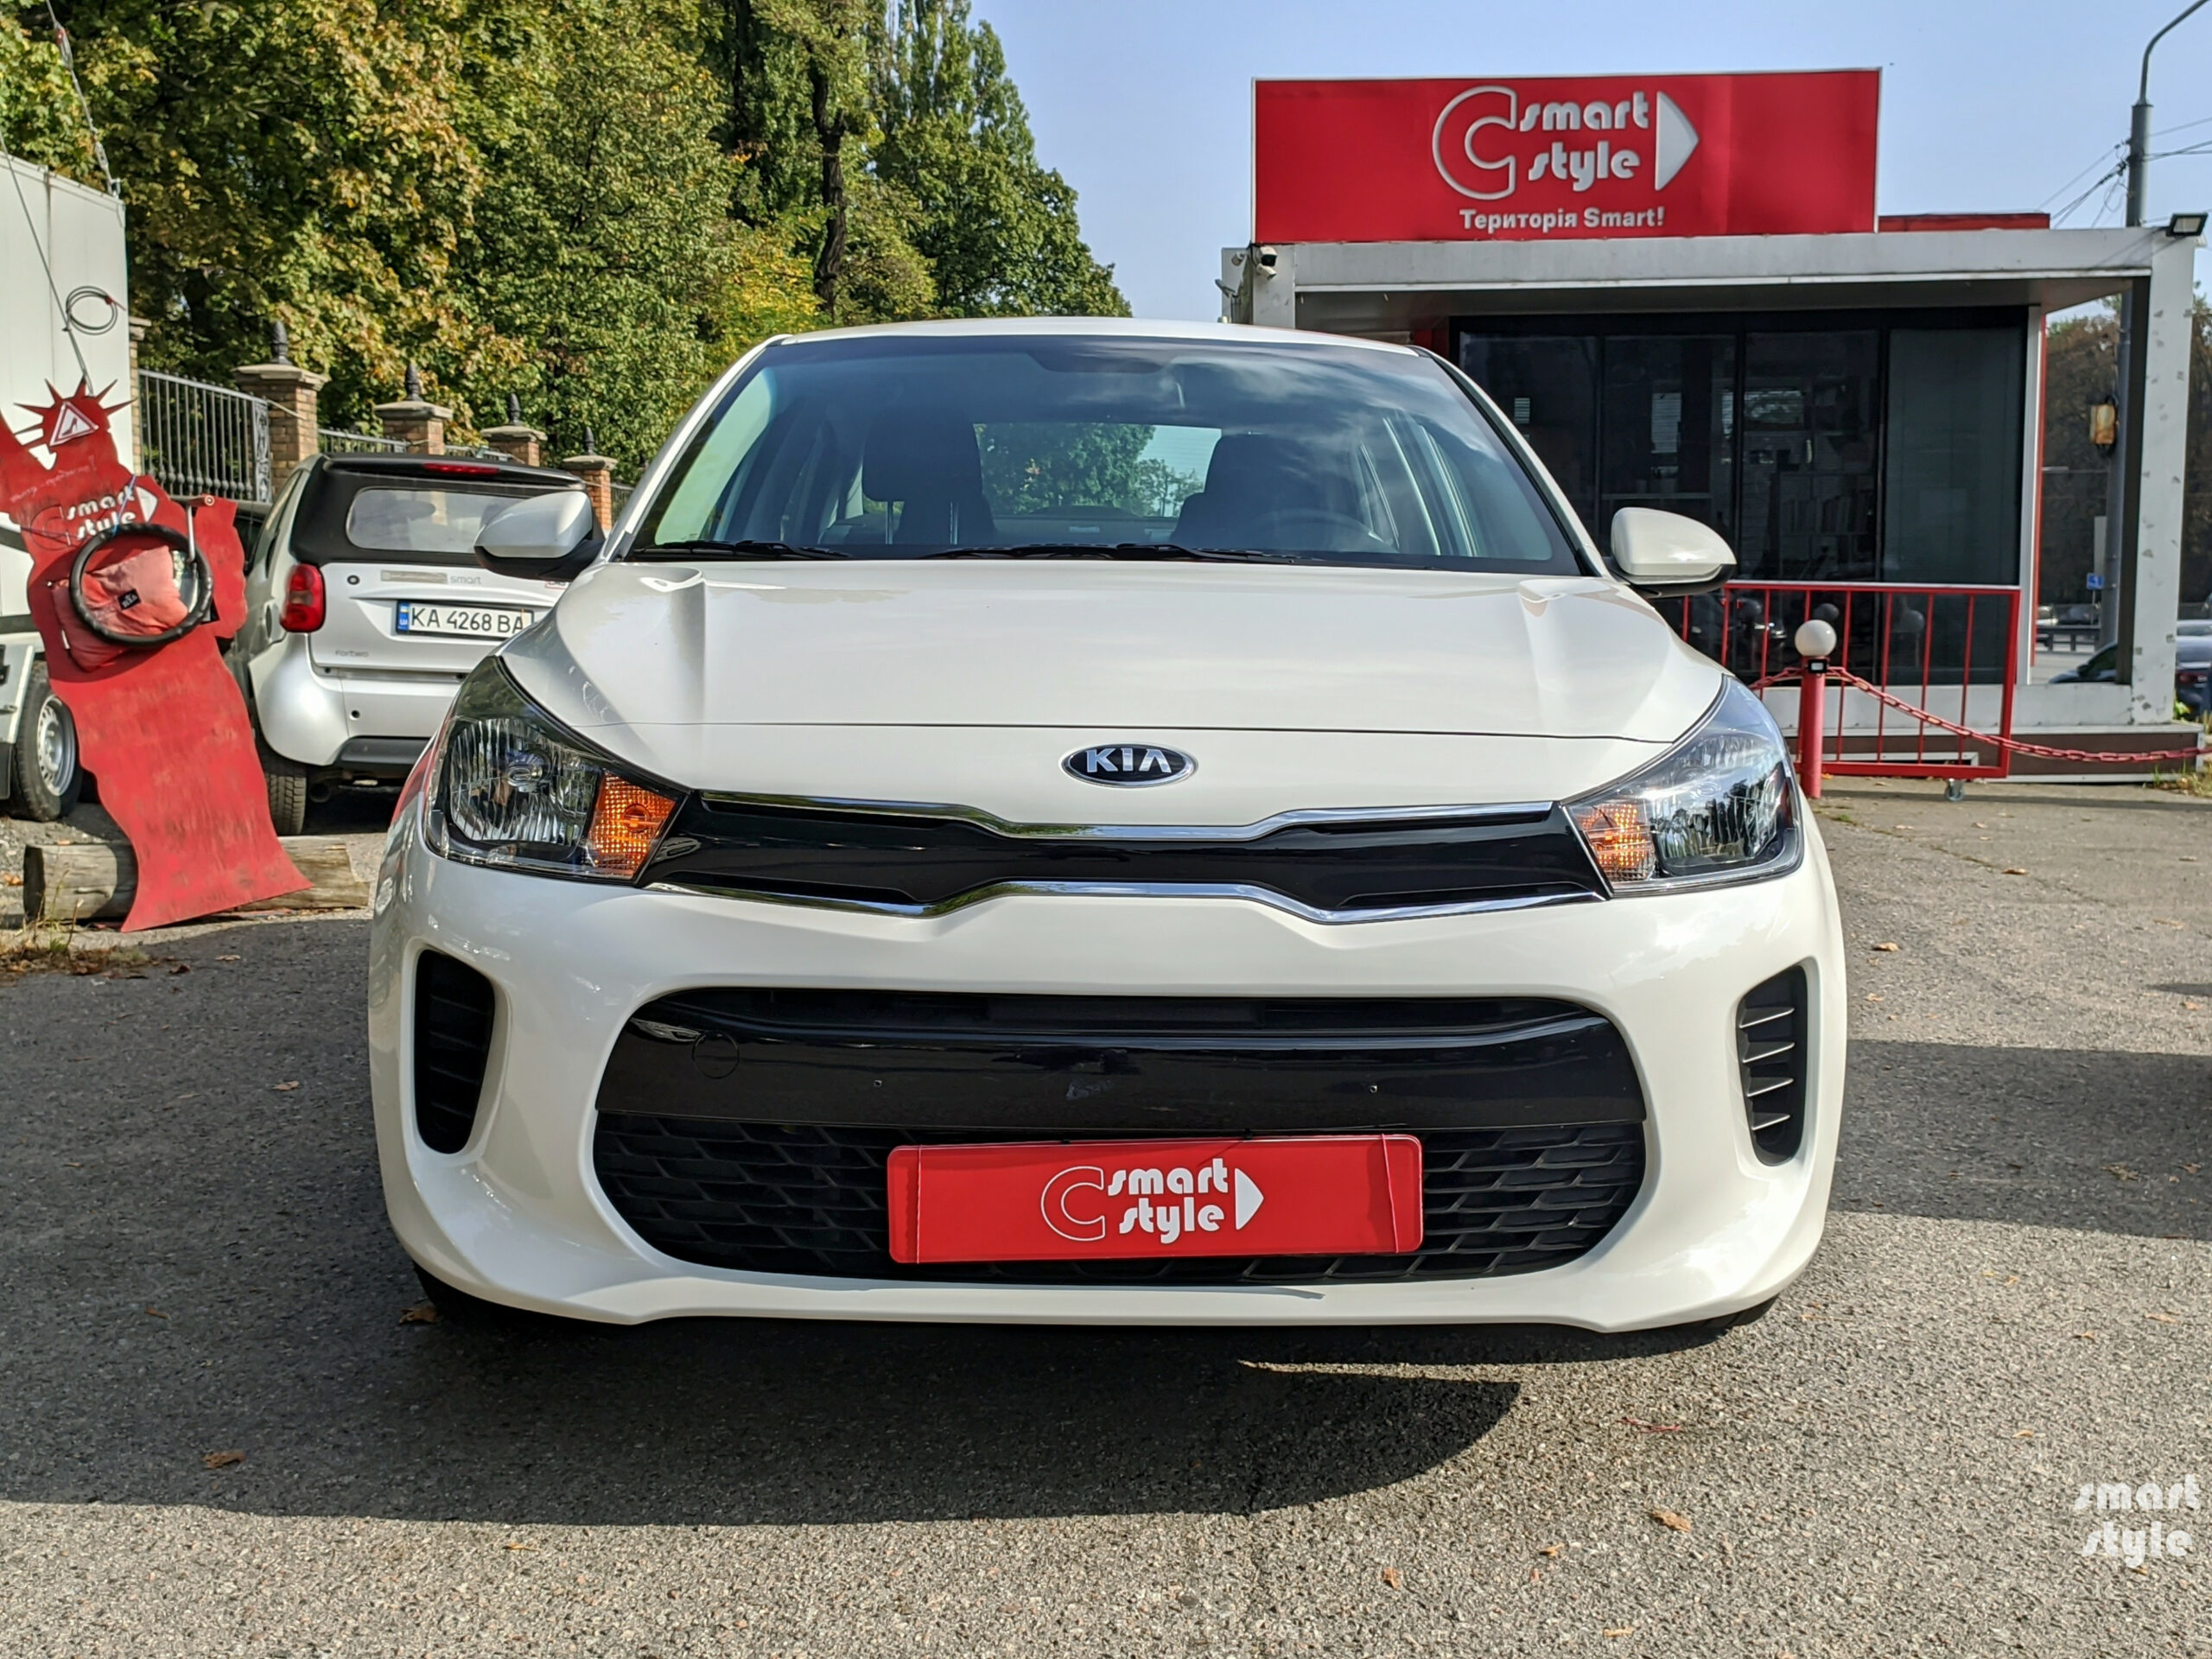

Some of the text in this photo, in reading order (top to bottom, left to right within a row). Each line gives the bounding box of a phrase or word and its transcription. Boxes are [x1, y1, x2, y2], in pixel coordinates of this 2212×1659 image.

[1519, 90, 1649, 132] smart
[1528, 140, 1641, 192] style
[1459, 207, 1665, 234] Територія Smart!
[67, 485, 136, 521] smart
[449, 575, 482, 585] smart
[410, 607, 441, 628] KA
[446, 611, 493, 632] 4268
[497, 614, 524, 634] BA
[1084, 747, 1173, 773] KIA
[1107, 1158, 1229, 1197] smart
[1119, 1196, 1225, 1244] style
